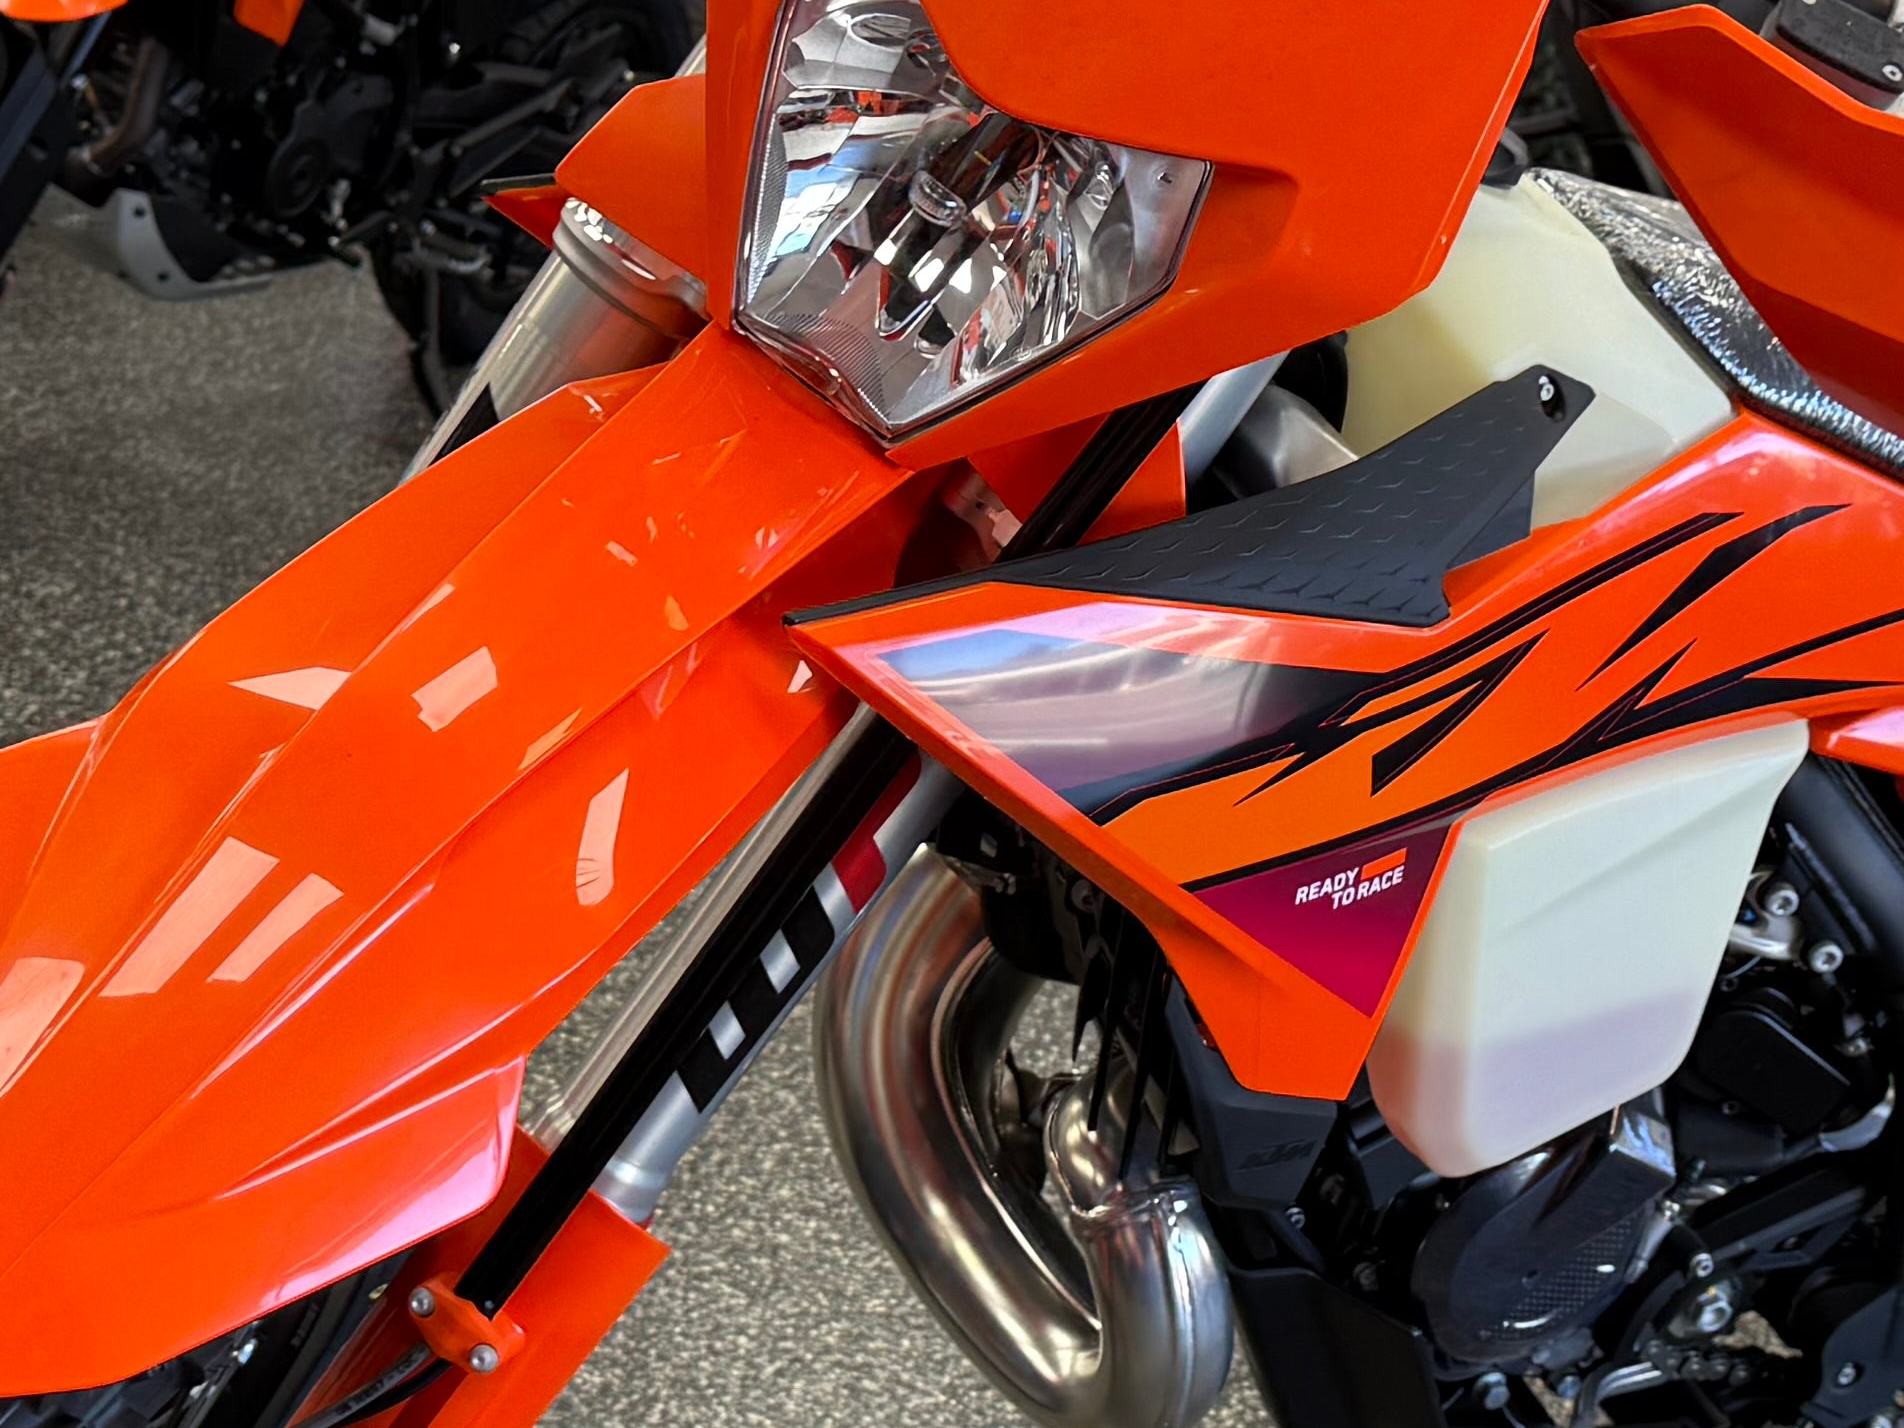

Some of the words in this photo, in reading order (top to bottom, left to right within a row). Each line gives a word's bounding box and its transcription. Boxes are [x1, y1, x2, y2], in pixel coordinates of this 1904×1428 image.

[1295, 866, 1360, 906] READY
[1331, 886, 1356, 910] TO
[1356, 864, 1405, 901] RACE
